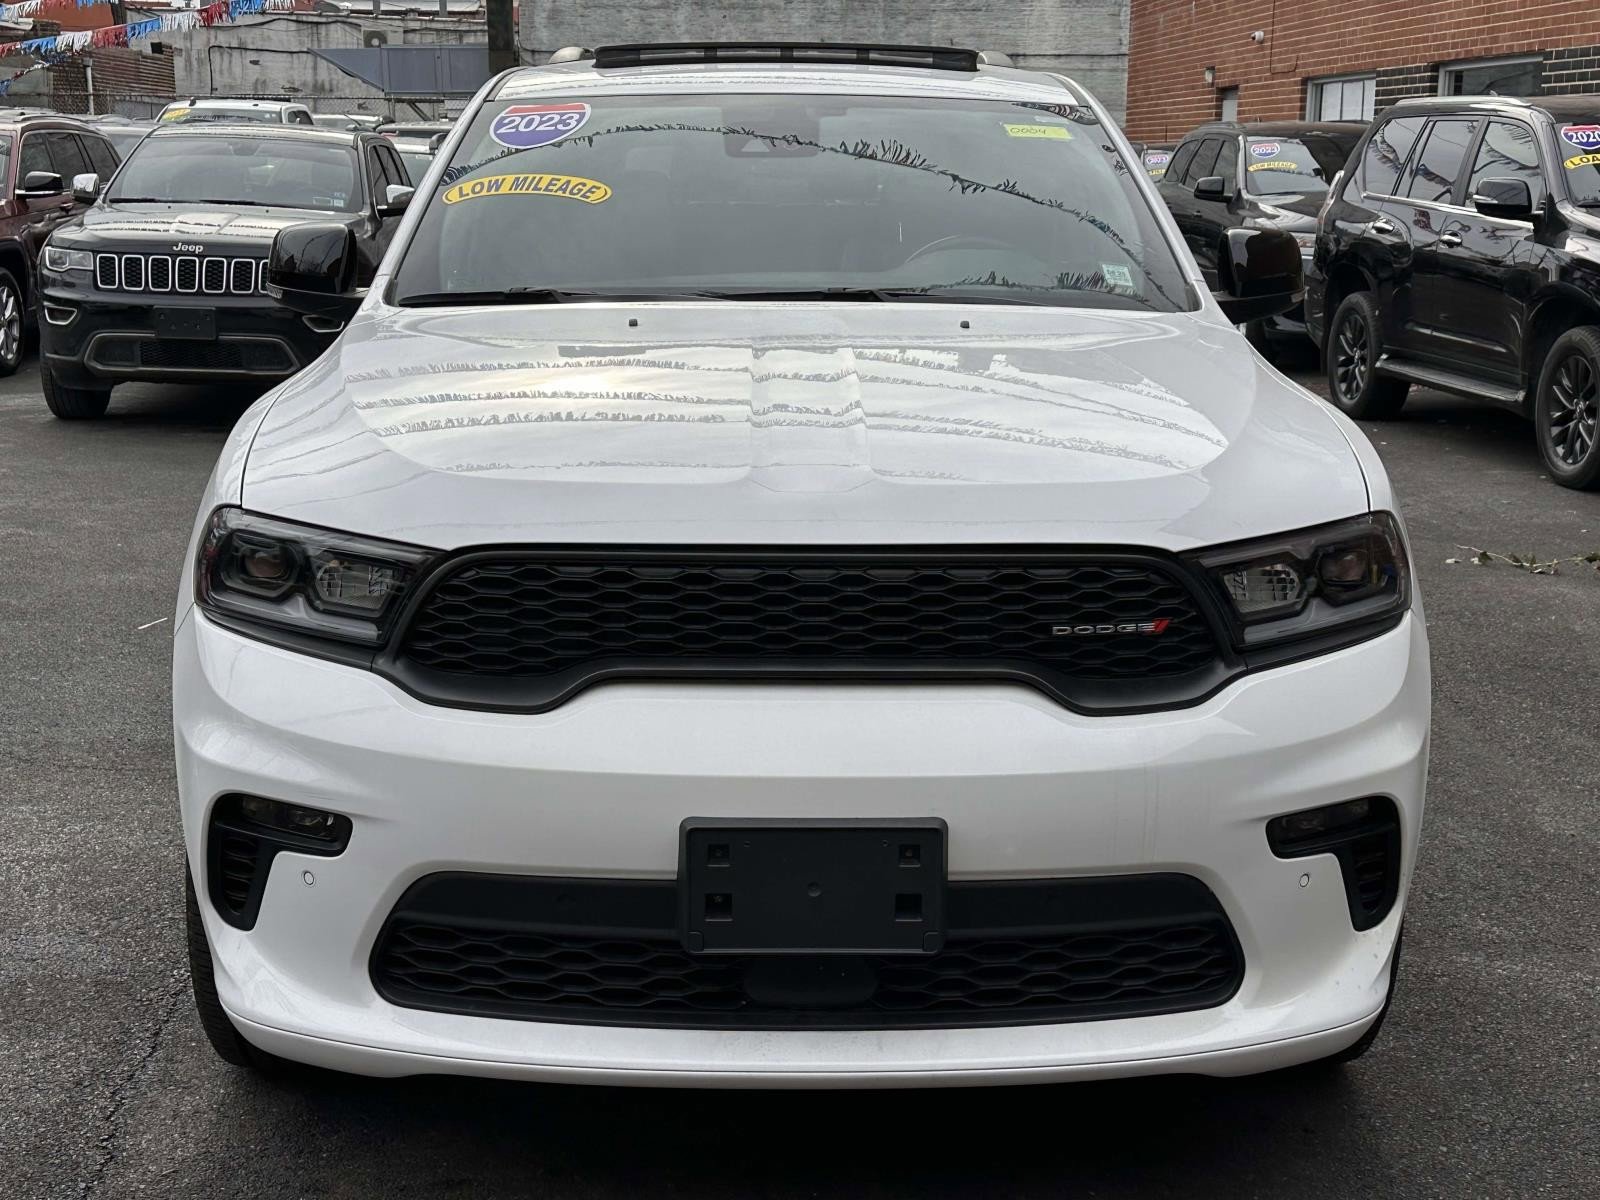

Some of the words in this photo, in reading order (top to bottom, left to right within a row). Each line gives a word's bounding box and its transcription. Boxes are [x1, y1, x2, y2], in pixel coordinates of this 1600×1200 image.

[496, 113, 580, 134] 2023
[457, 177, 507, 199] LOW
[508, 175, 600, 200] MILEAGE
[172, 242, 204, 255] Jeep
[1052, 623, 1155, 634] DODGE
